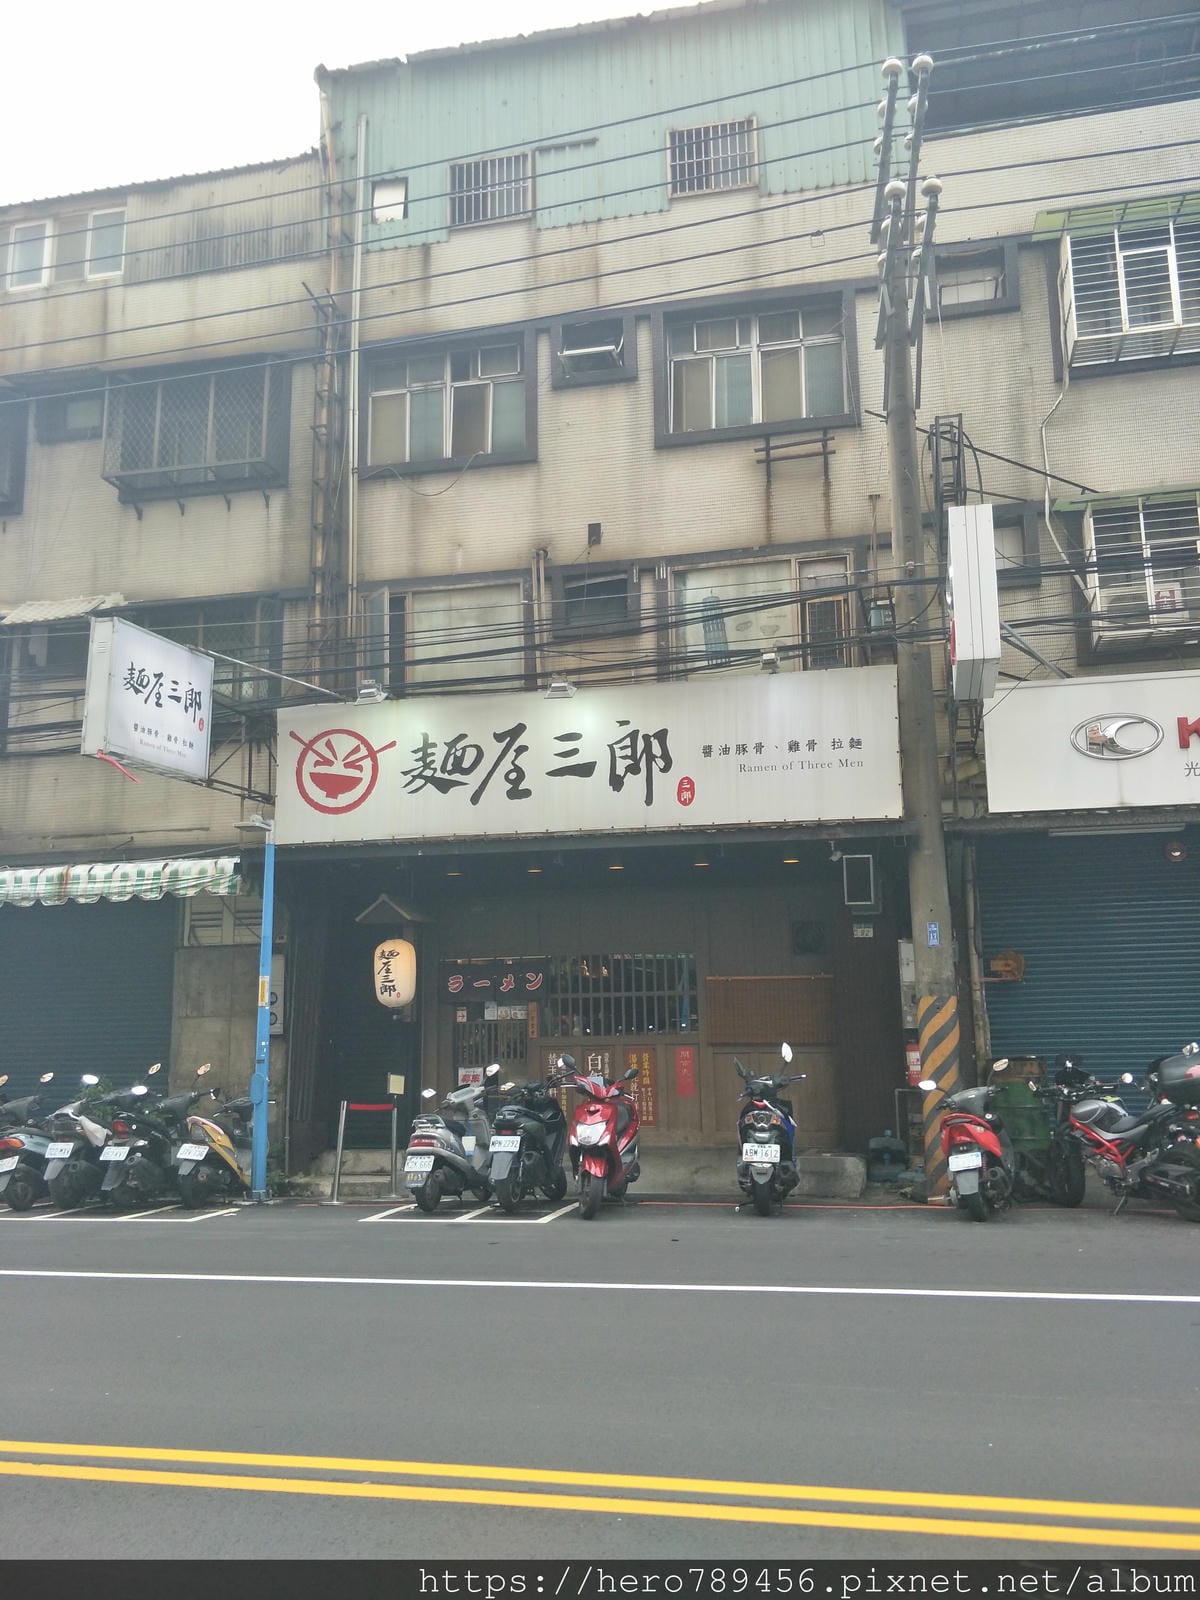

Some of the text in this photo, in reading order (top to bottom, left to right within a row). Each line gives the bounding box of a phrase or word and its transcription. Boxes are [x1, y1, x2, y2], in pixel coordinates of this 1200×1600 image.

[400, 720, 673, 807] 麵屋三郎
[739, 758, 864, 773] Ramen of Three Men
[447, 972, 543, 993] ラーメン
